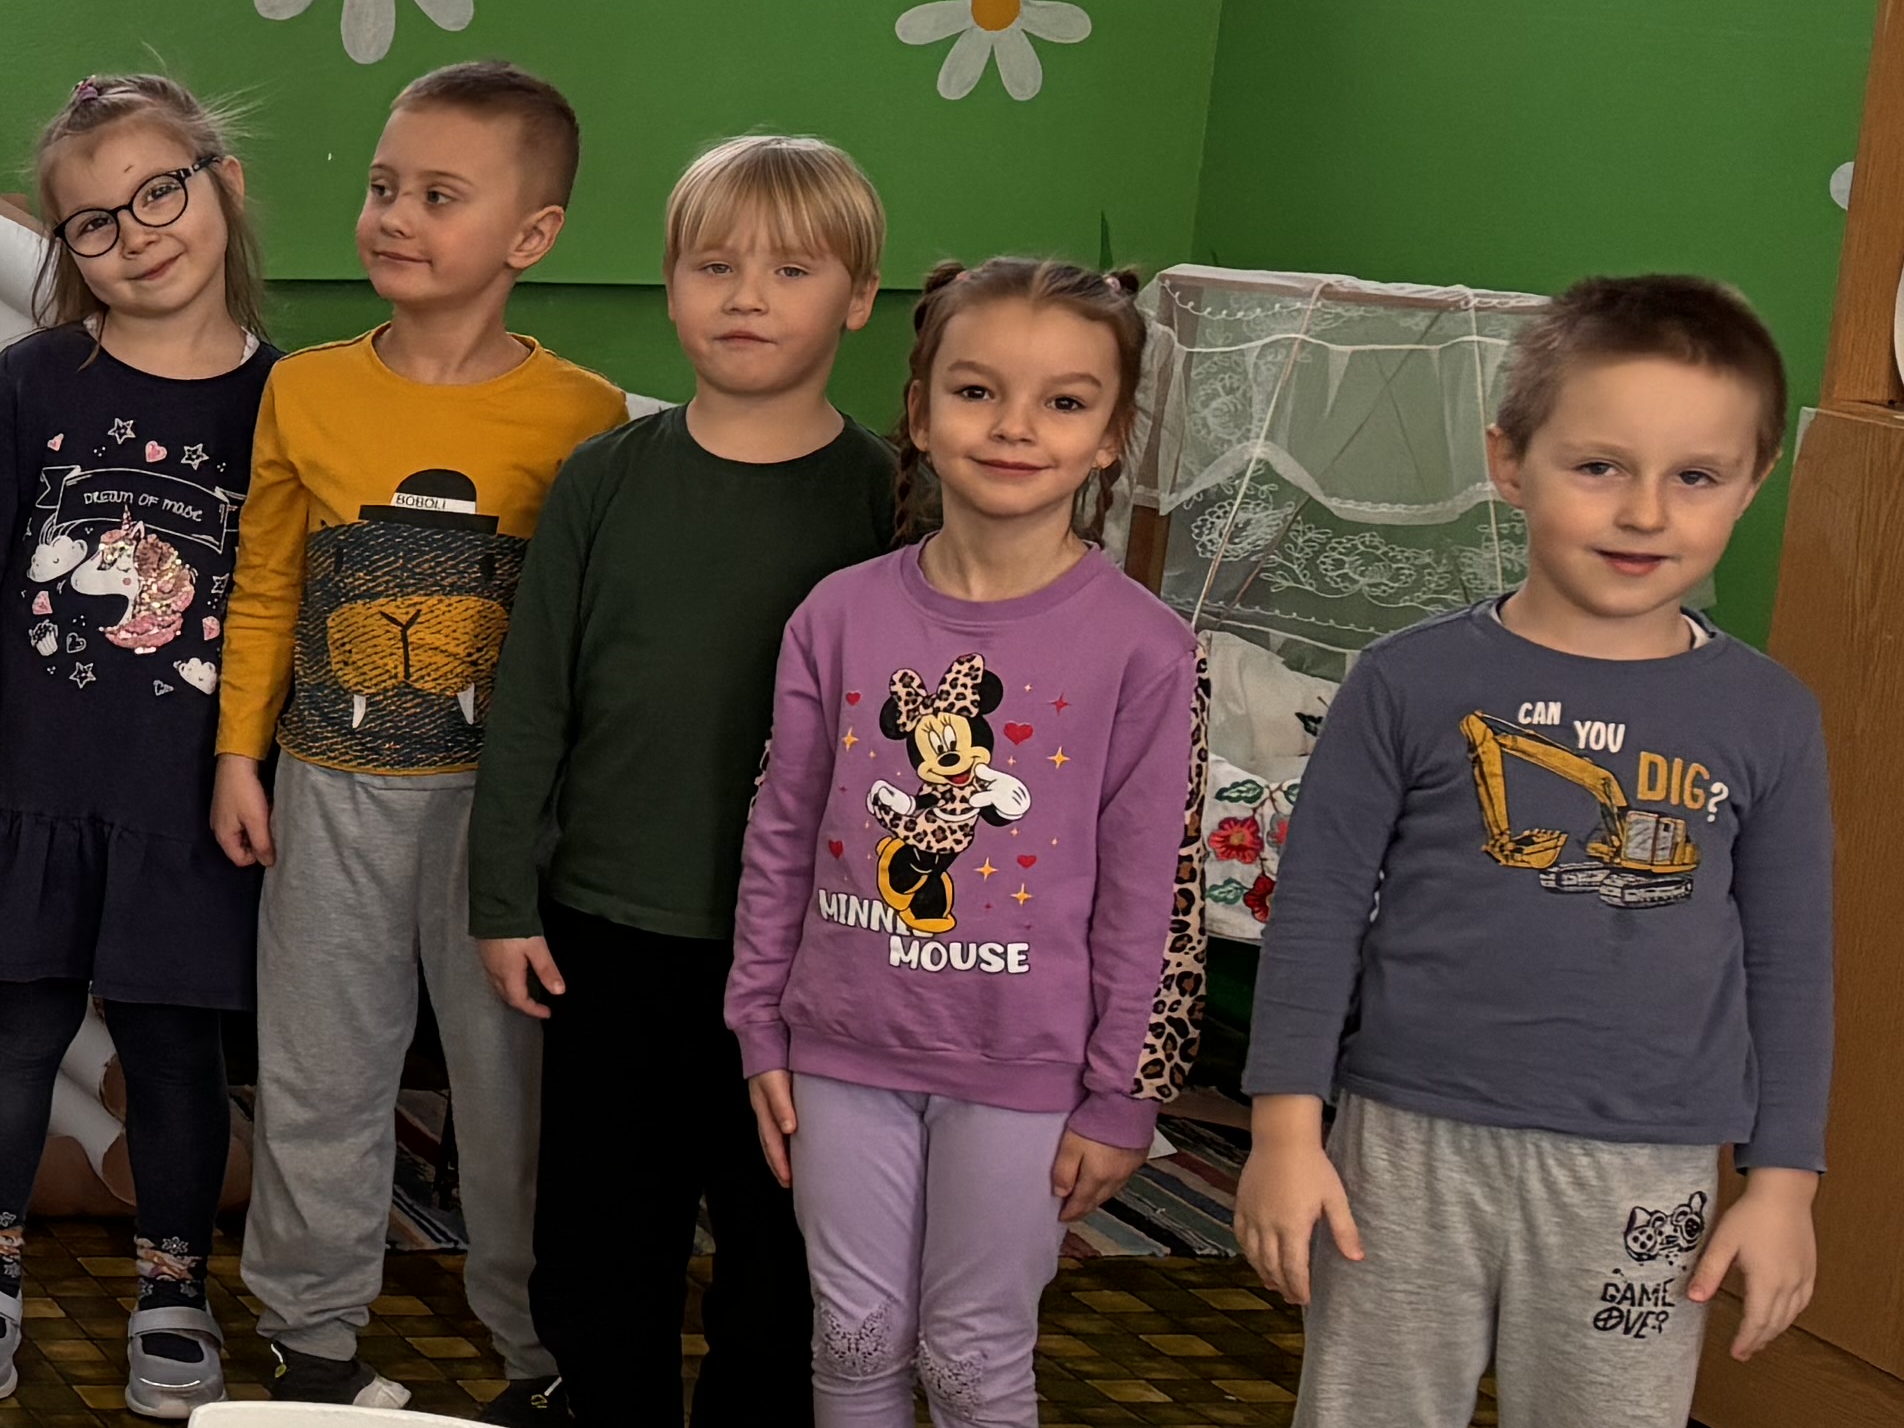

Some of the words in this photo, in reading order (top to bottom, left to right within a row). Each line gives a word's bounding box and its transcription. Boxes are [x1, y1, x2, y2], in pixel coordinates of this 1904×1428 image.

[1517, 700, 1562, 726] CAN
[1573, 719, 1625, 753] YOU
[1637, 751, 1730, 823] DIG?
[818, 888, 935, 939] MINNI
[889, 935, 1031, 974] MOUSE
[1600, 1276, 1676, 1309] GAME
[1593, 1303, 1669, 1339] OVER
